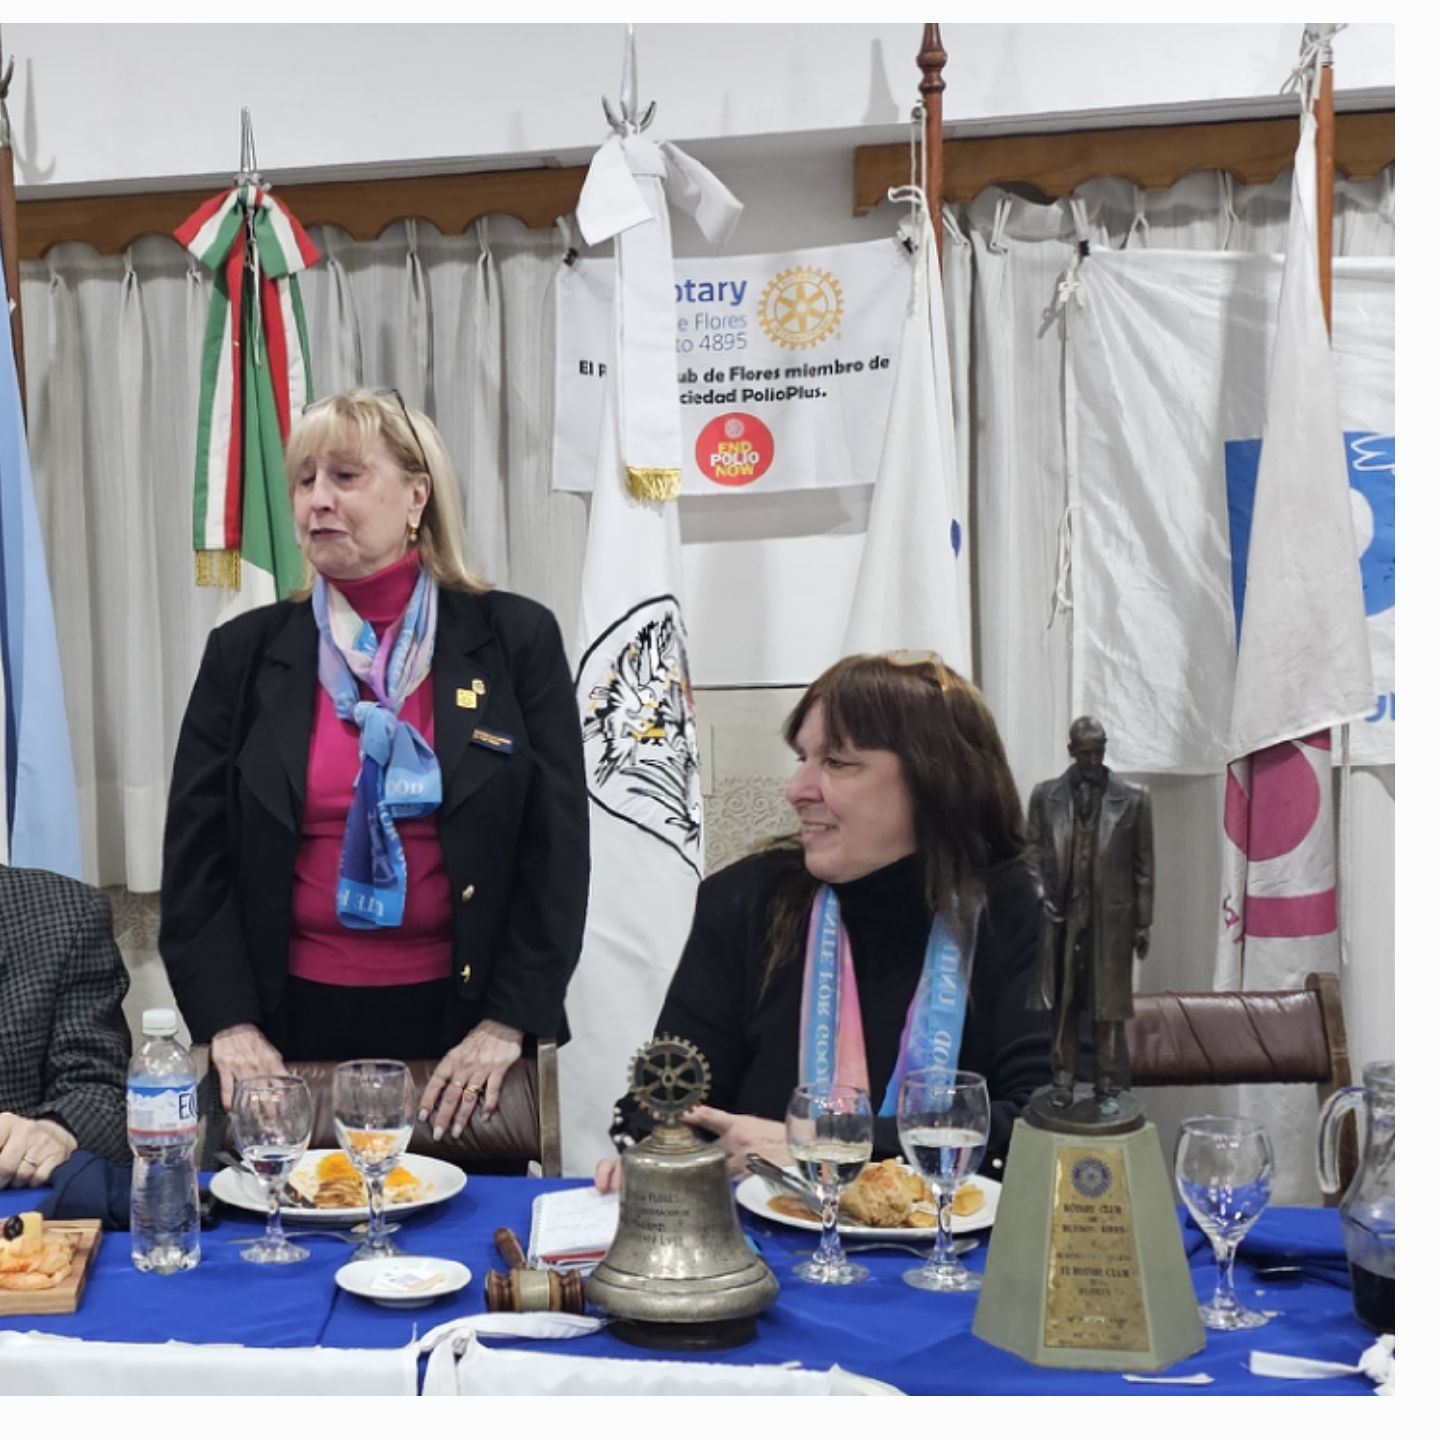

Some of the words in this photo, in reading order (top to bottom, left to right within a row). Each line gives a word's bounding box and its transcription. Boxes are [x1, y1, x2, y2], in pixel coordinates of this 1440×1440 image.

[695, 311, 748, 330] Flores
[699, 331, 748, 352] 4895
[579, 360, 594, 376] El
[703, 366, 725, 383] de
[729, 364, 780, 383] Flores
[785, 359, 864, 379] miembro
[868, 355, 891, 370] de
[680, 388, 737, 405] ciedad
[742, 385, 828, 403] PolioPlus.
[718, 440, 752, 454] END
[710, 451, 759, 467] POLIO
[715, 463, 755, 478] NOW
